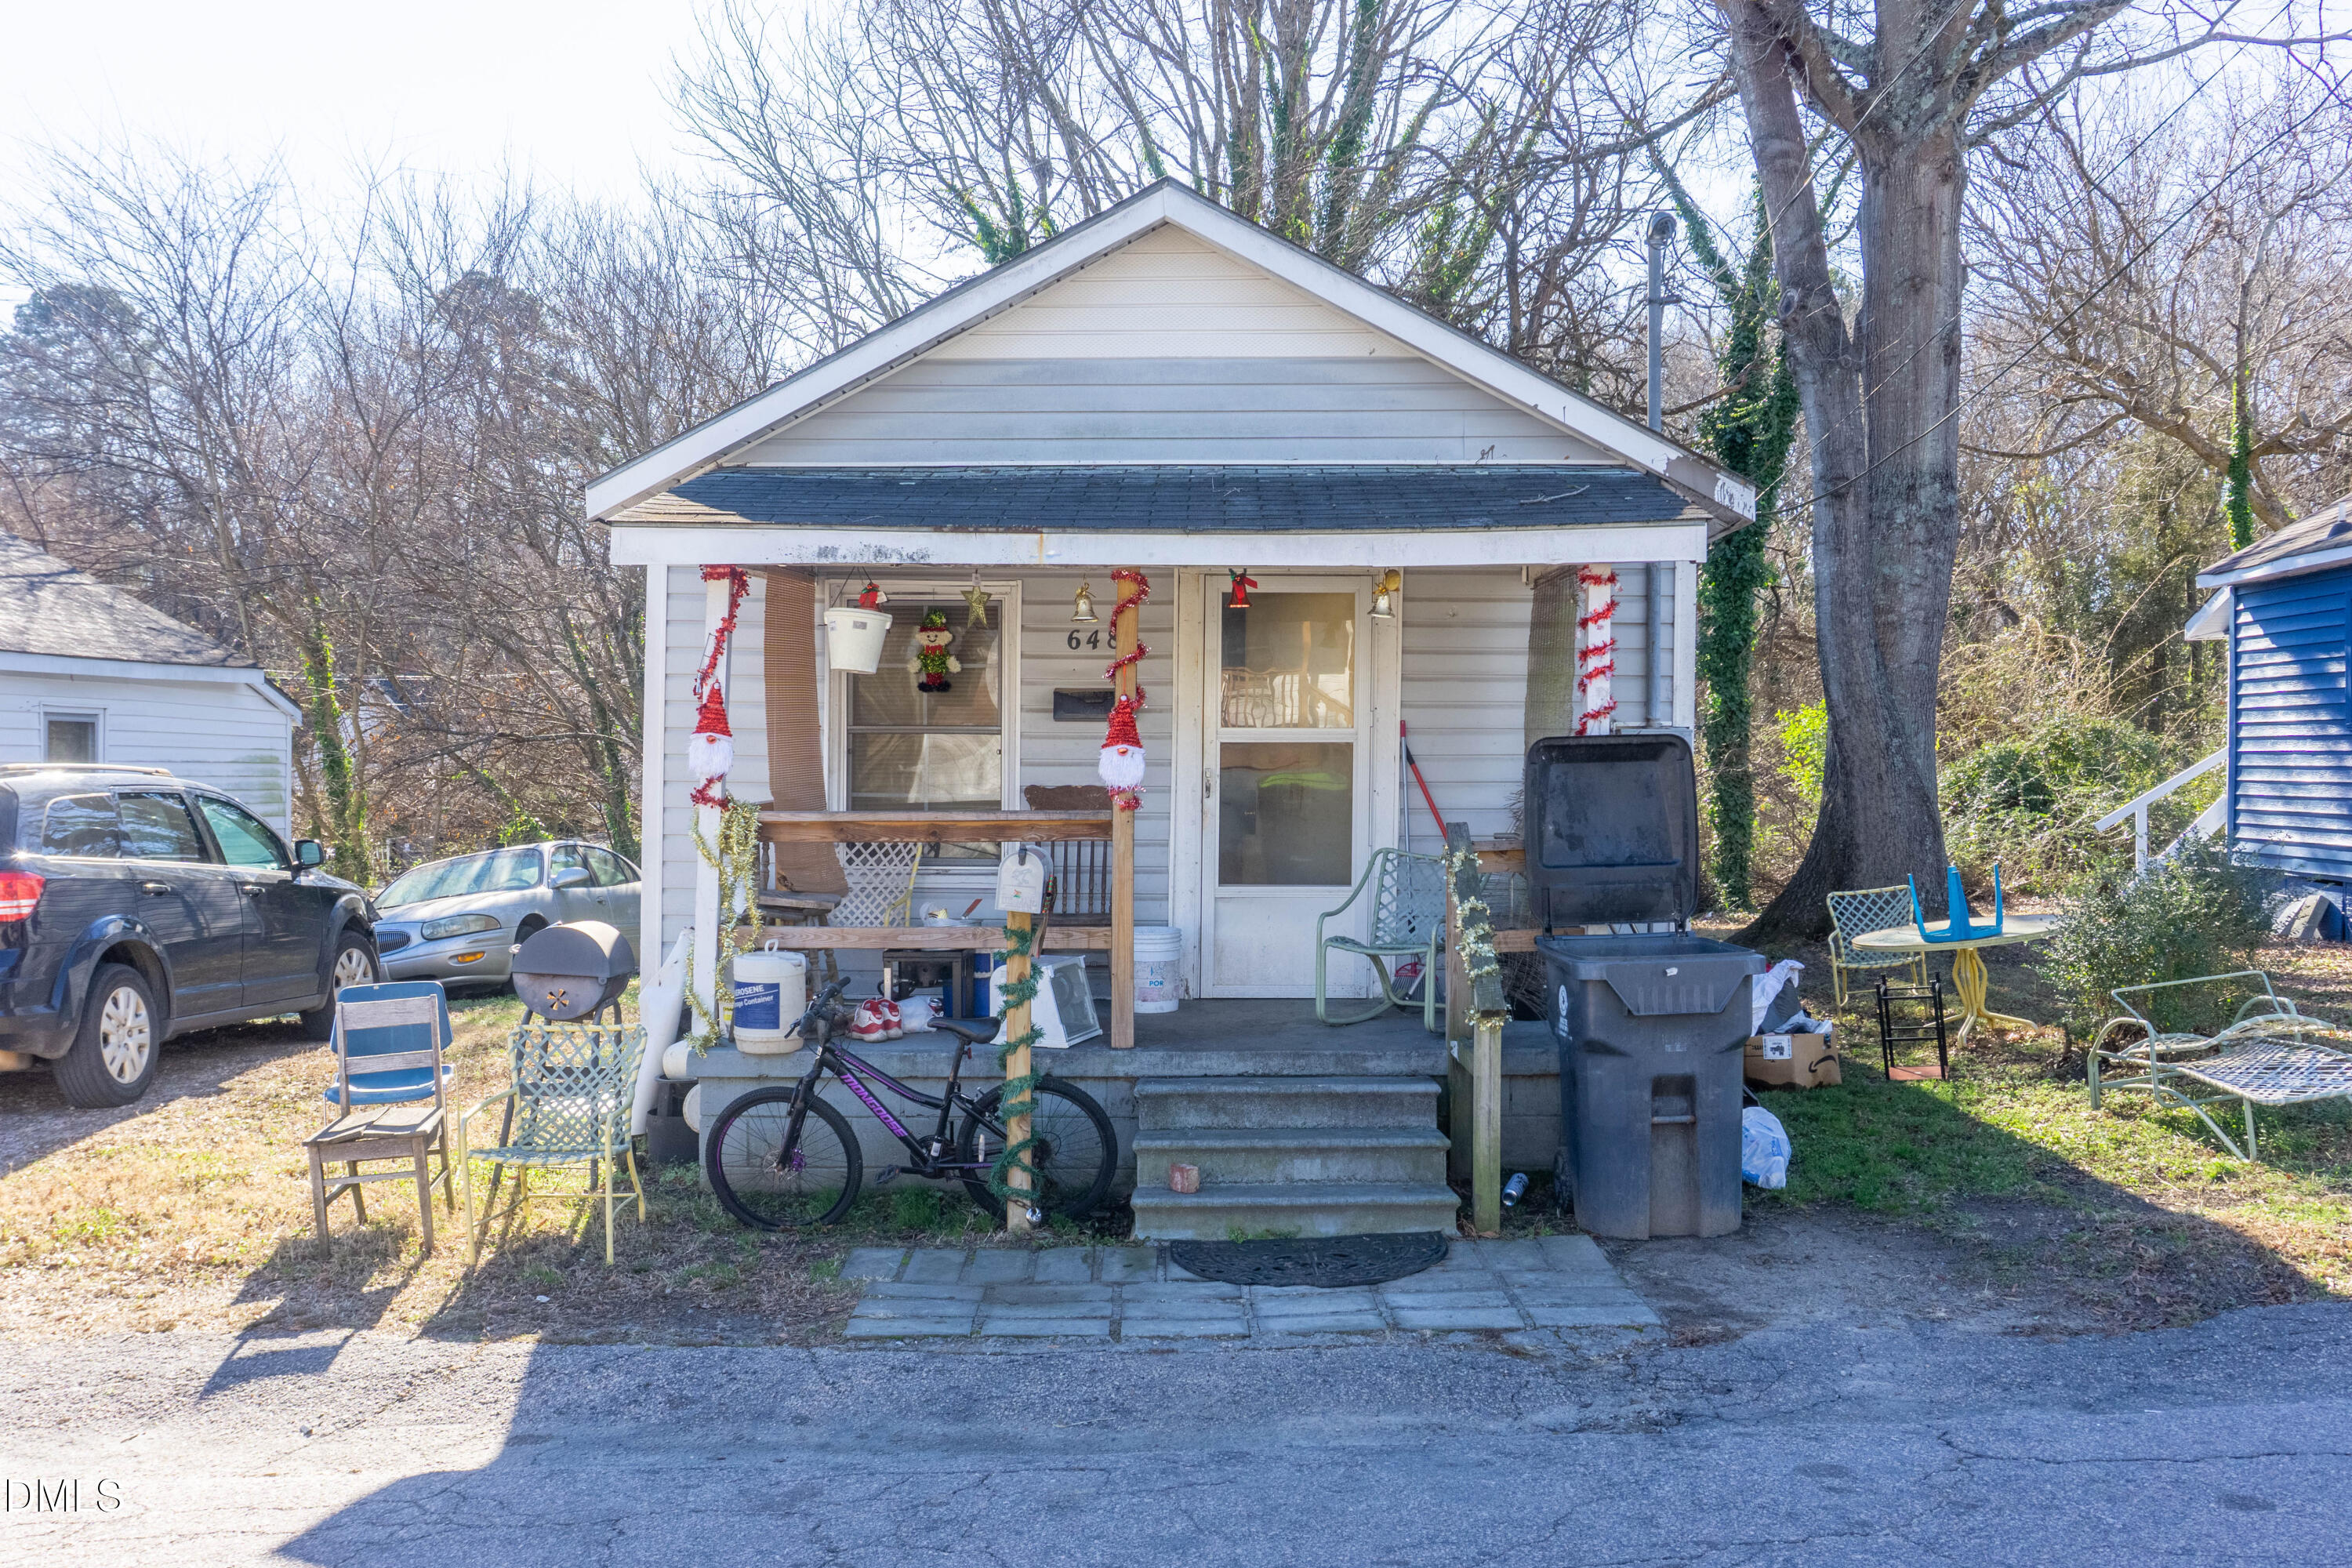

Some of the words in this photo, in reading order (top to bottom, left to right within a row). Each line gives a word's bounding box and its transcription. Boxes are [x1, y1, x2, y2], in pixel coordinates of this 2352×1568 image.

[735, 985, 764, 996] EROSENE
[744, 995, 774, 1006] Container
[840, 1073, 908, 1137] MONGOOSE
